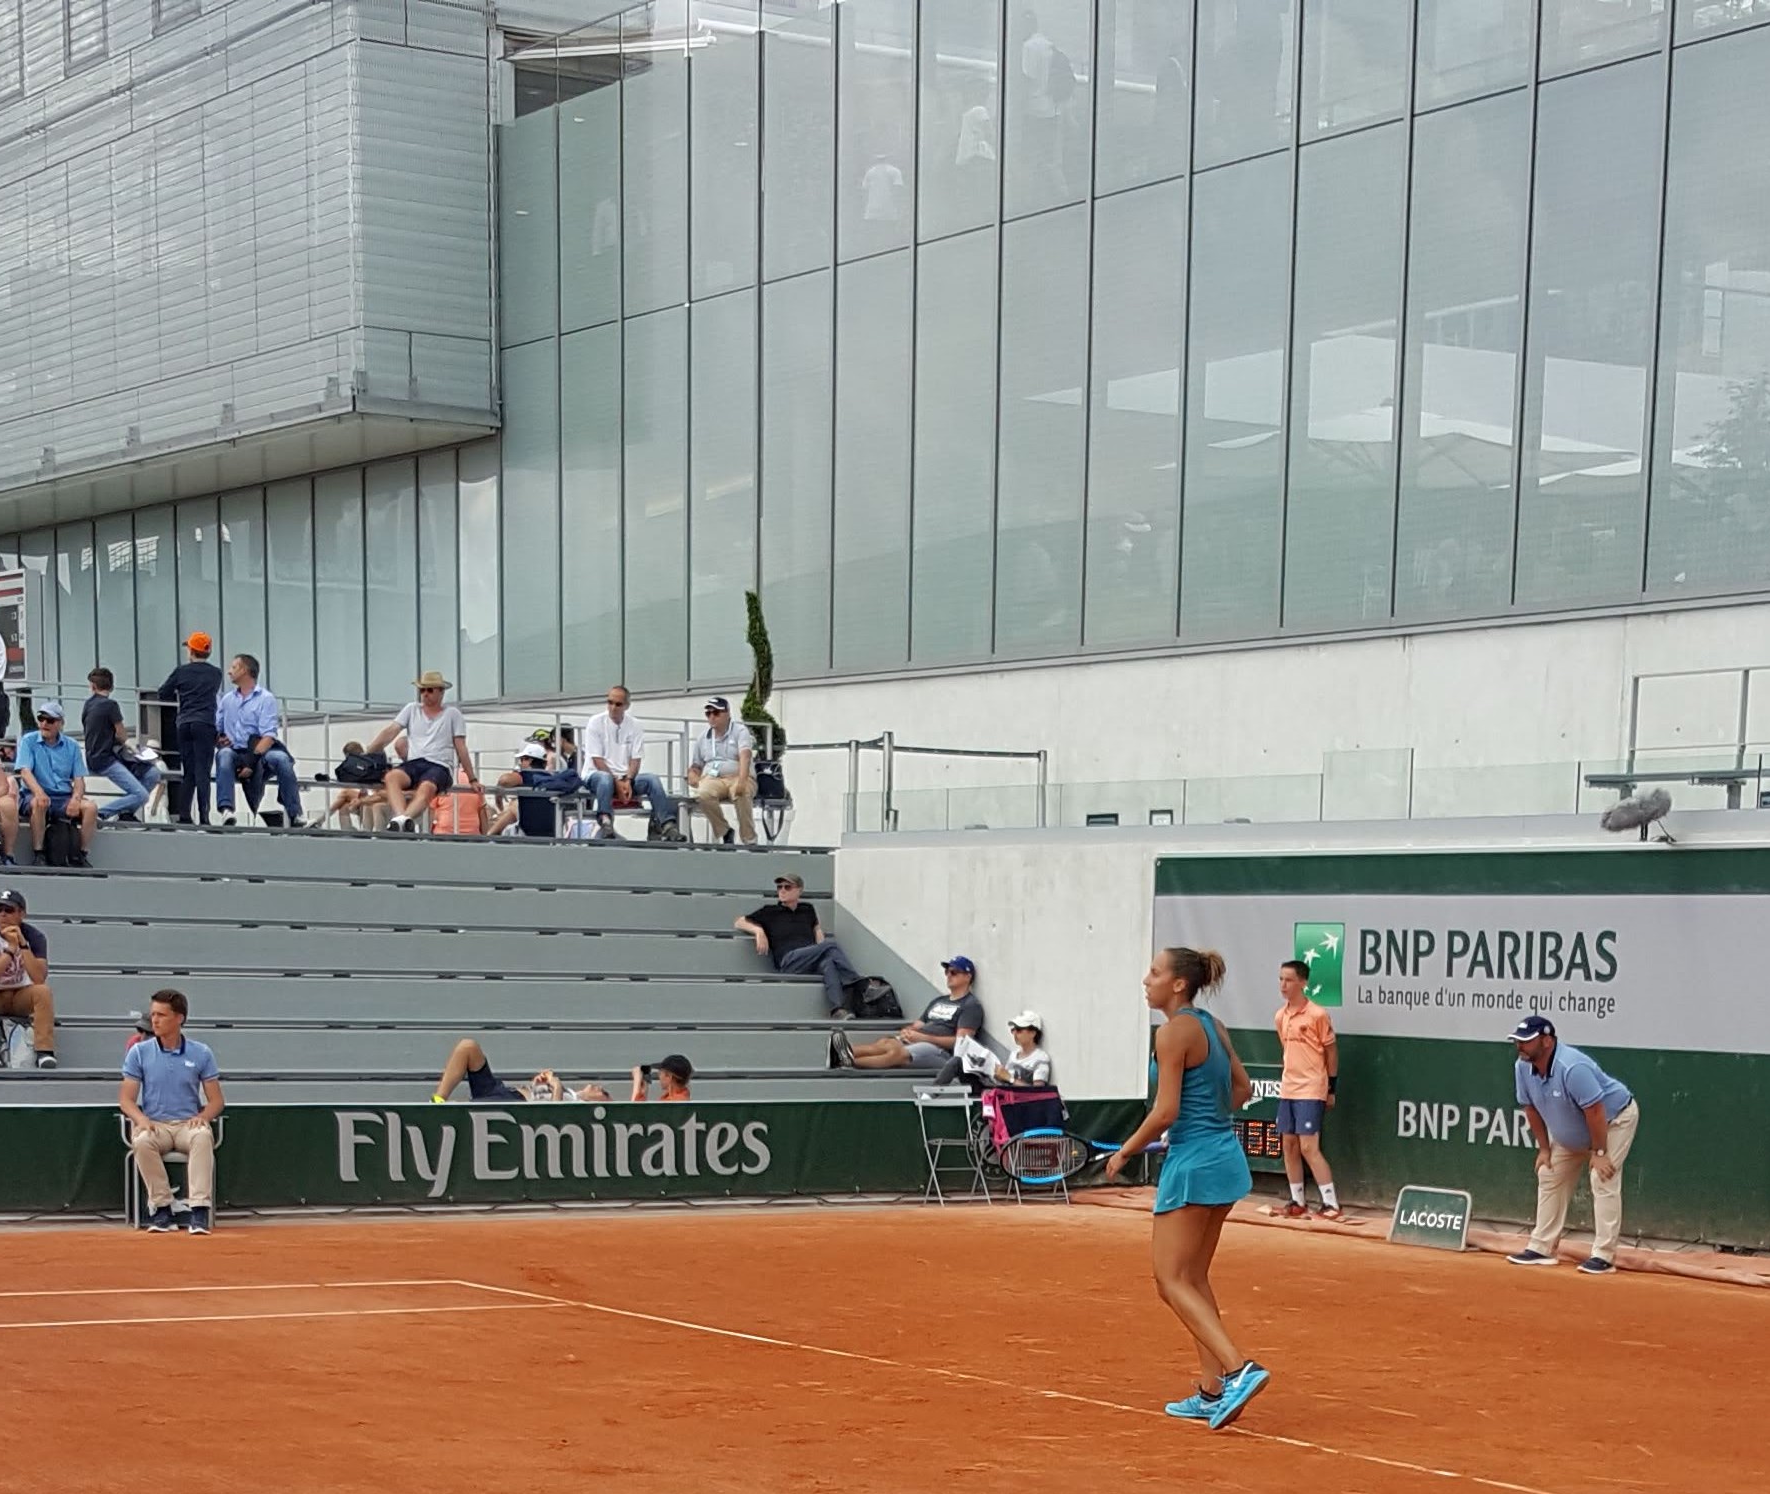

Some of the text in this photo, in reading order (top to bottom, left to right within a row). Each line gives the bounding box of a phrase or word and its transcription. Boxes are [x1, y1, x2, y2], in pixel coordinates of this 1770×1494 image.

[1359, 929, 1618, 983] BNP PARIBAS
[1358, 985, 1616, 1019] La banque d'un monde qui change
[1397, 1101, 1460, 1141] BNP
[335, 1104, 772, 1198] Fly Emirates
[1400, 1210, 1463, 1231] LACOSTE
